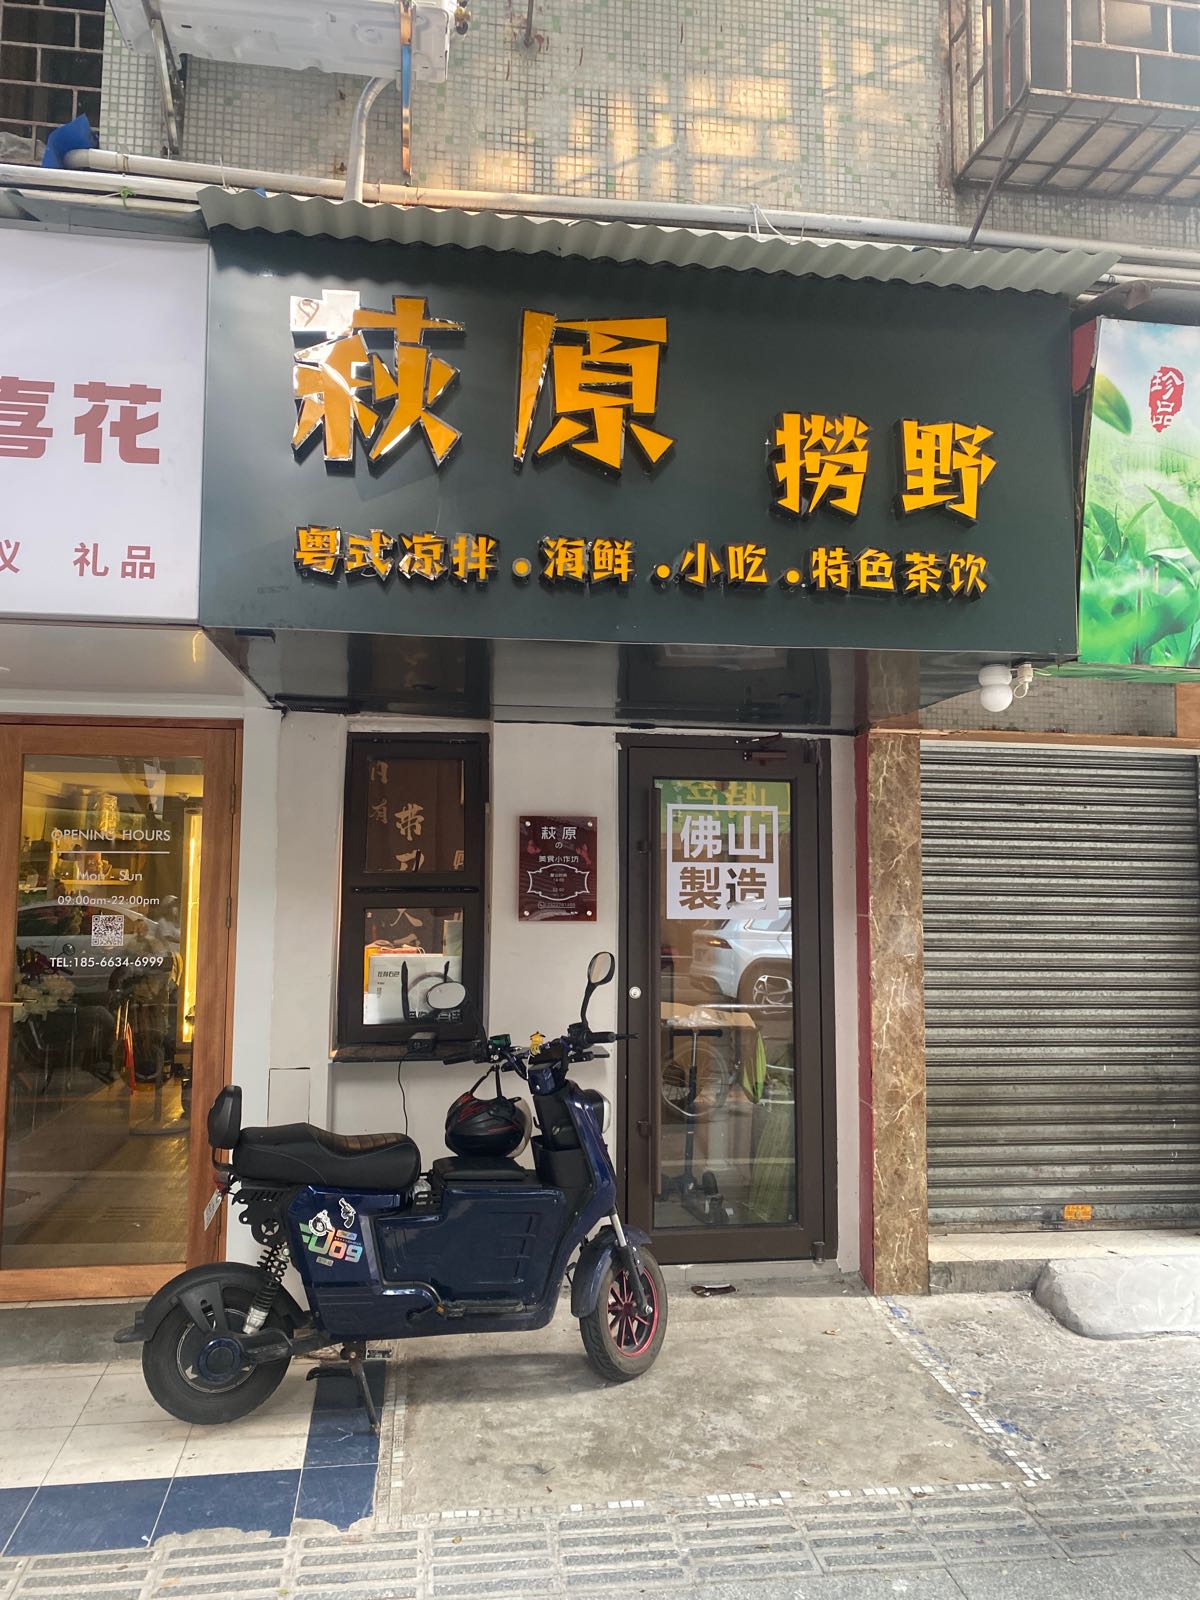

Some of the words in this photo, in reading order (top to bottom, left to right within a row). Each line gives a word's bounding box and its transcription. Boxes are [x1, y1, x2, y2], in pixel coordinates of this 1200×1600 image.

[1151, 370, 1184, 425] 珍品
[776, 412, 997, 520] 撈野
[72, 542, 155, 579] 礼品
[51, 829, 116, 841] OPENING
[122, 829, 171, 841] HOURS
[680, 815, 767, 860] 佛山
[80, 870, 106, 881] Mon
[119, 870, 143, 881] Sun
[678, 866, 767, 911] 製造
[57, 895, 160, 907] 09:00am-22:00pm
[49, 957, 164, 968] TEL:185-6634-6999
